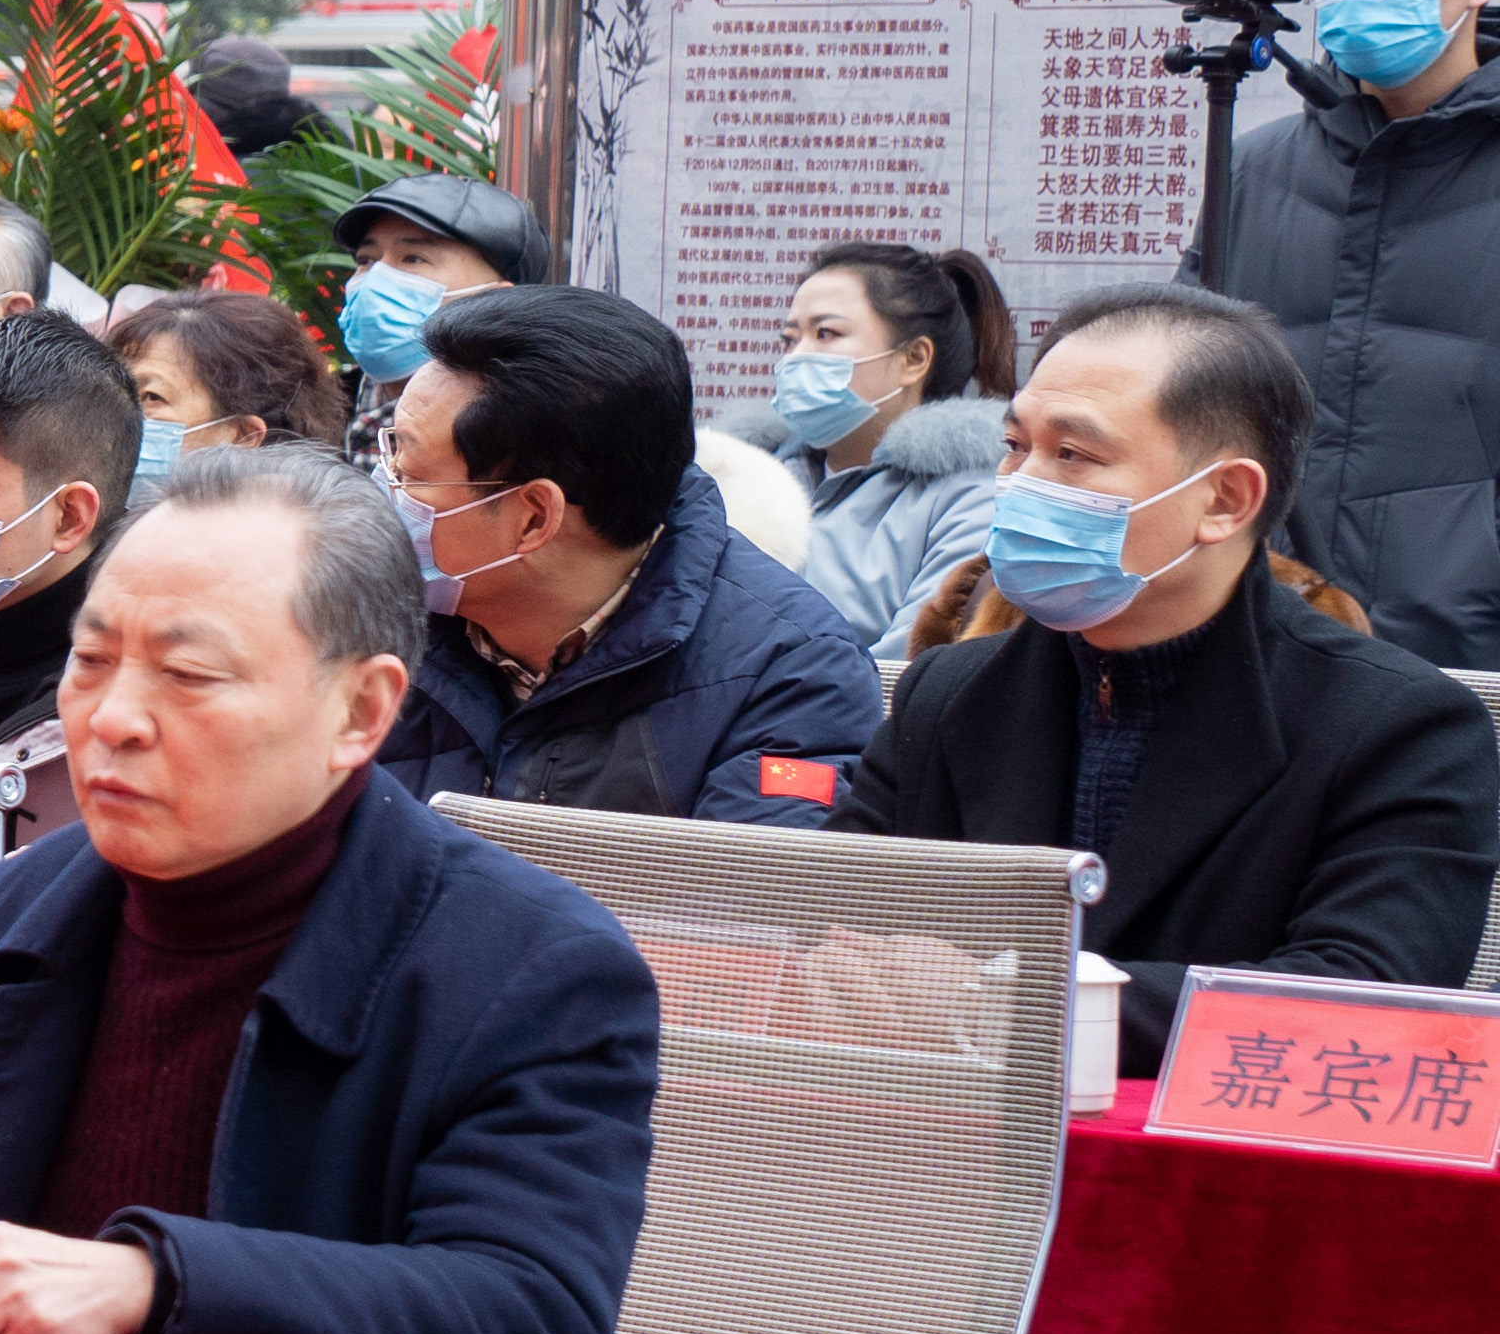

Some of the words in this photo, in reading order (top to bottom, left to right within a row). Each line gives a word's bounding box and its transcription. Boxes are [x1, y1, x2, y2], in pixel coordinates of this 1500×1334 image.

[1043, 26, 1202, 51] 天地之间人为贵，
[1041, 56, 1201, 80] 头象天穹足象。
[1041, 85, 1199, 109] 父母遗体宜保之，
[1040, 114, 1199, 139] 箕裘五福寿为最。
[1038, 144, 1196, 168] 卫生切要知三戒，
[1037, 173, 1196, 198] 大怒大欲并大醉。
[1036, 202, 1194, 227] 三者若还有一焉，
[1201, 1029, 1489, 1132] 嘉宾席
